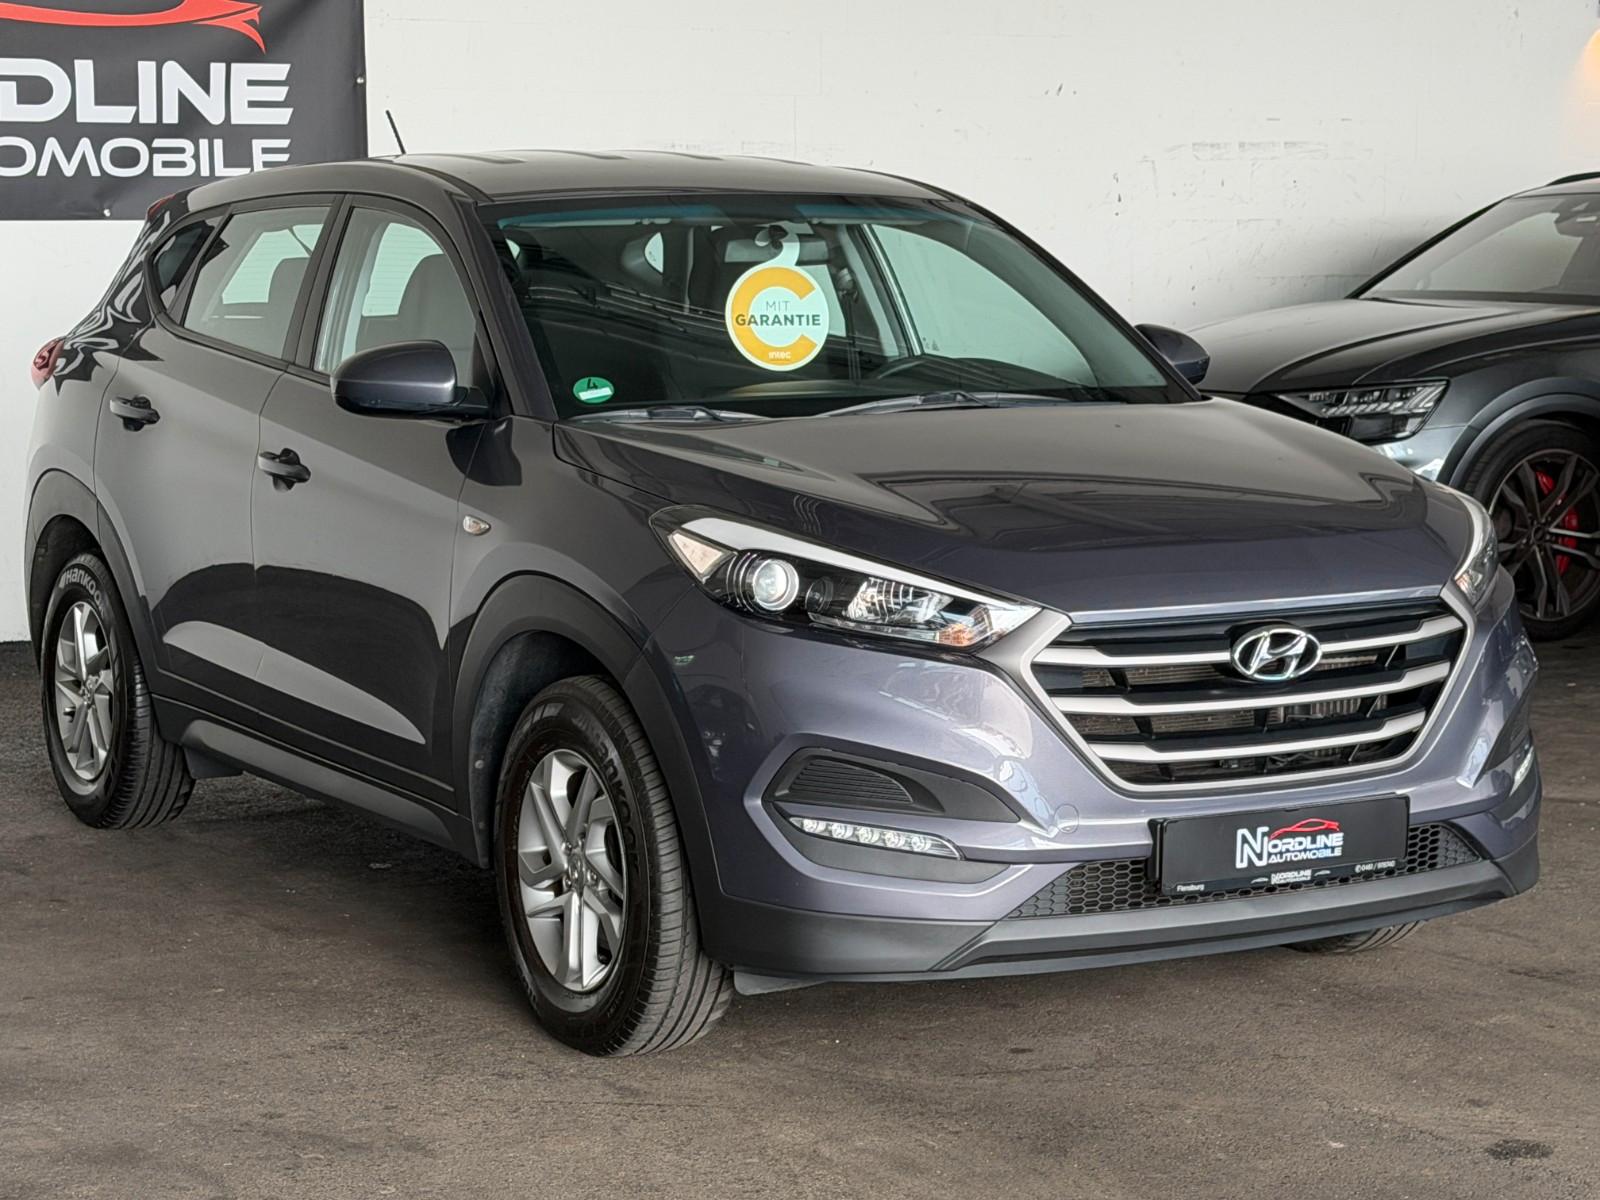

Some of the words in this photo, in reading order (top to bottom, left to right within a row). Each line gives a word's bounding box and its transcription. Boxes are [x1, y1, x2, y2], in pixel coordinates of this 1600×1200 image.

[766, 301, 790, 311] MIT
[735, 313, 822, 327] GARANTIE
[1236, 826, 1344, 869] NORDLINE
[1268, 847, 1343, 864] AUTOMOBILE
